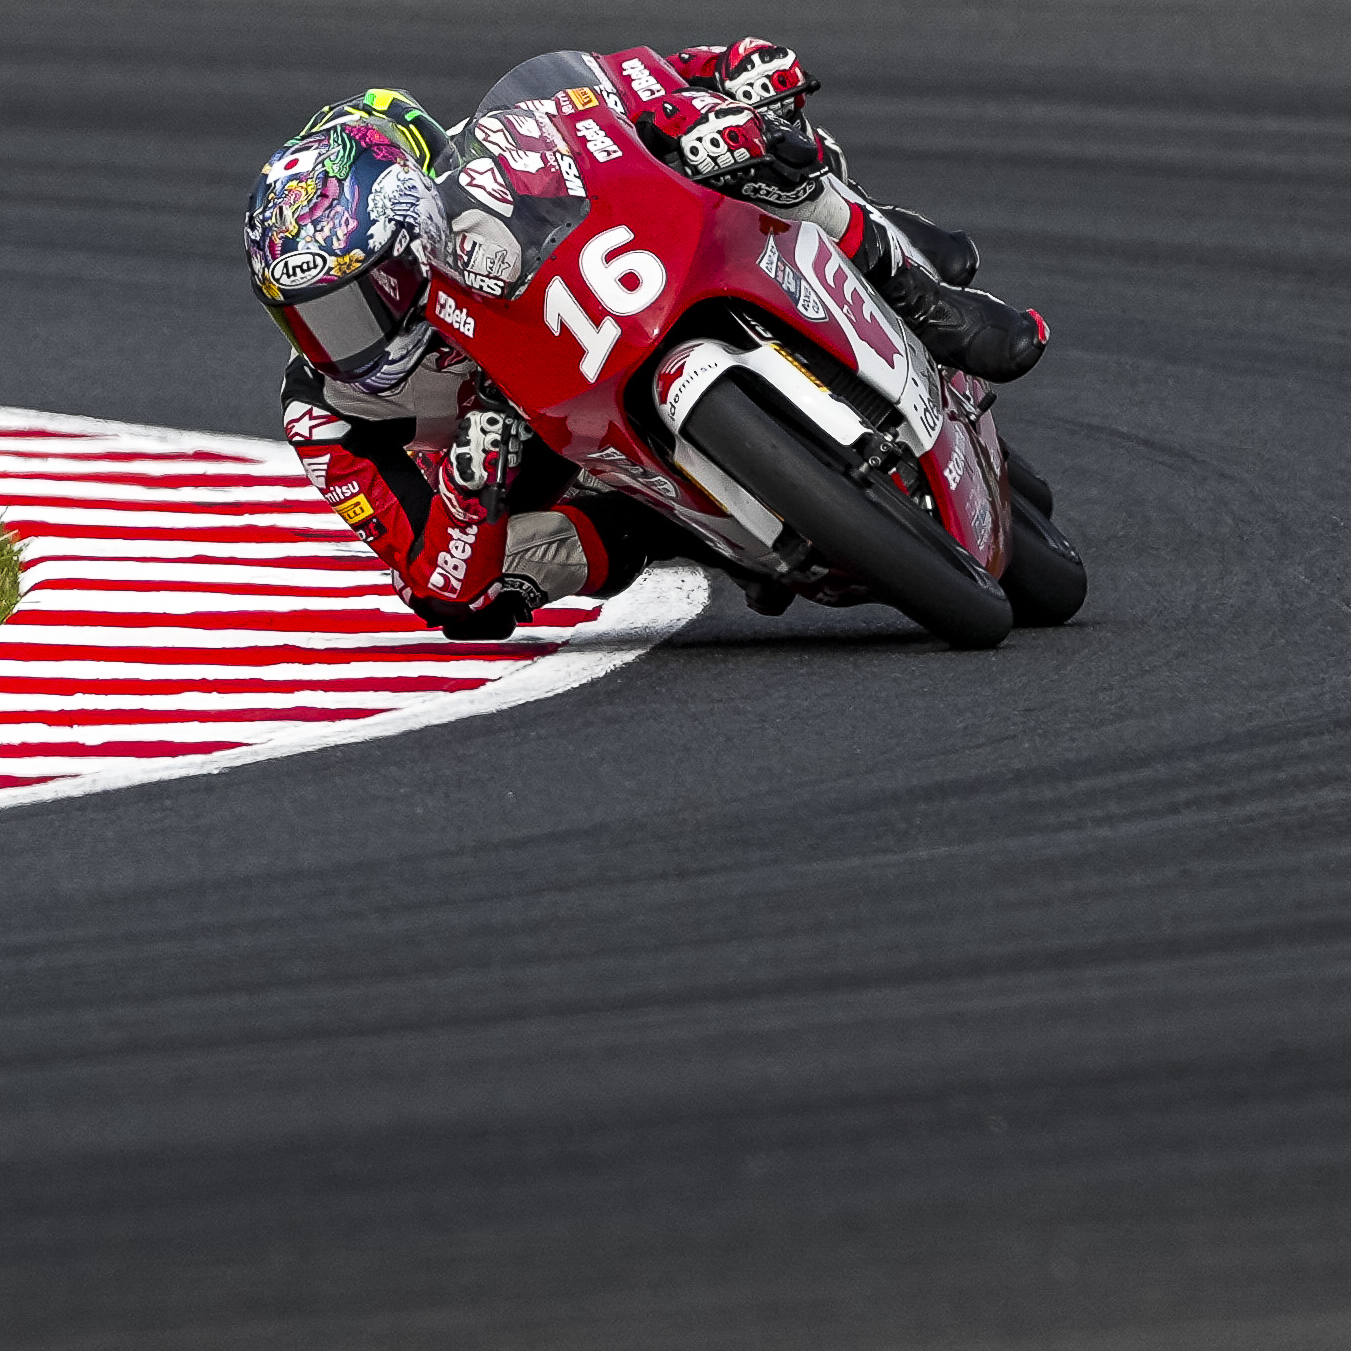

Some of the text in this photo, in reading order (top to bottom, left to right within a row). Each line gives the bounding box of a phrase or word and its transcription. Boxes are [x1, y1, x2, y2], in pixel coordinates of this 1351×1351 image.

[575, 119, 615, 152] Beta
[556, 151, 587, 197] WRS
[464, 270, 504, 295] WRS
[544, 225, 667, 384] 16
[444, 295, 475, 339] Beta
